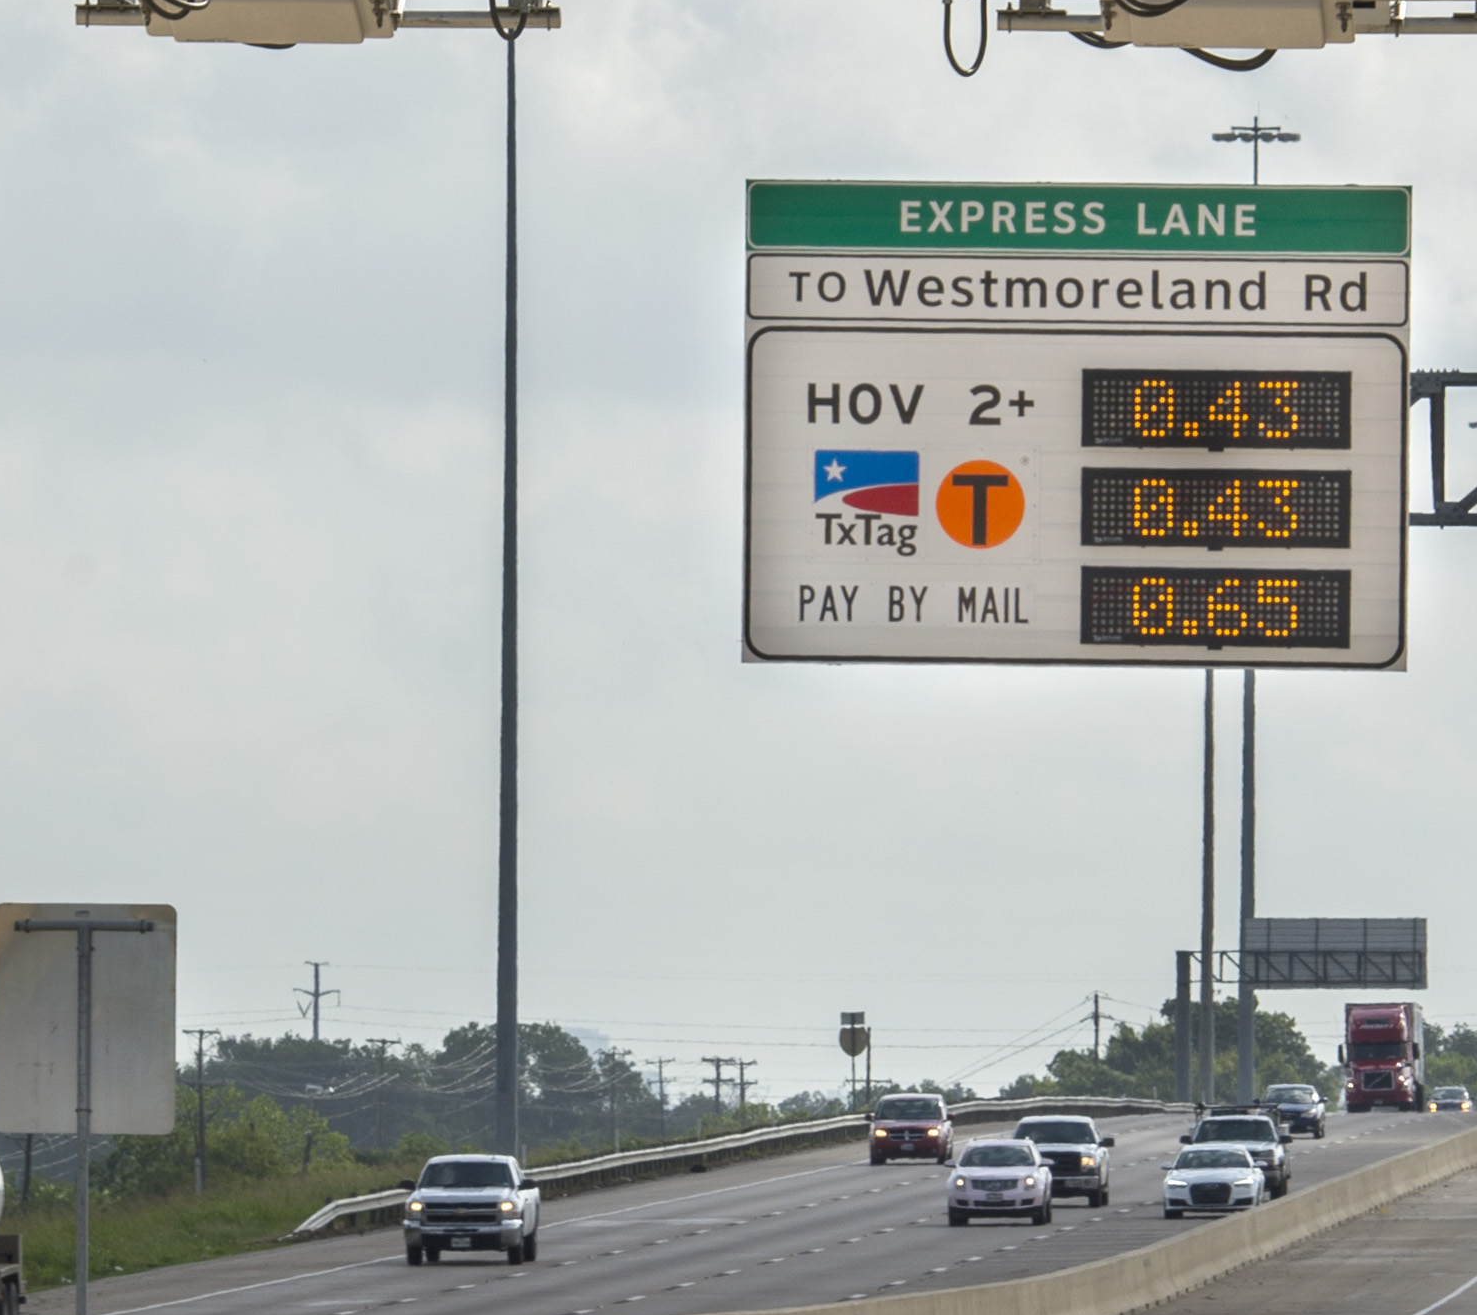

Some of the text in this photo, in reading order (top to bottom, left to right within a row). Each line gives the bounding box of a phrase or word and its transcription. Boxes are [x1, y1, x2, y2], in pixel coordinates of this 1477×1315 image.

[900, 200, 1257, 237] EXPRESS LANE
[789, 269, 1367, 312] TO Westmoreland Rd
[807, 382, 1035, 425] HOV 2+
[1134, 379, 1299, 438] 0.43
[952, 474, 1009, 546] T
[1133, 478, 1299, 537] 0.43
[815, 513, 918, 557] TxTag
[799, 584, 1030, 624] PAY BY MAIL
[1132, 577, 1298, 637] 0.65
